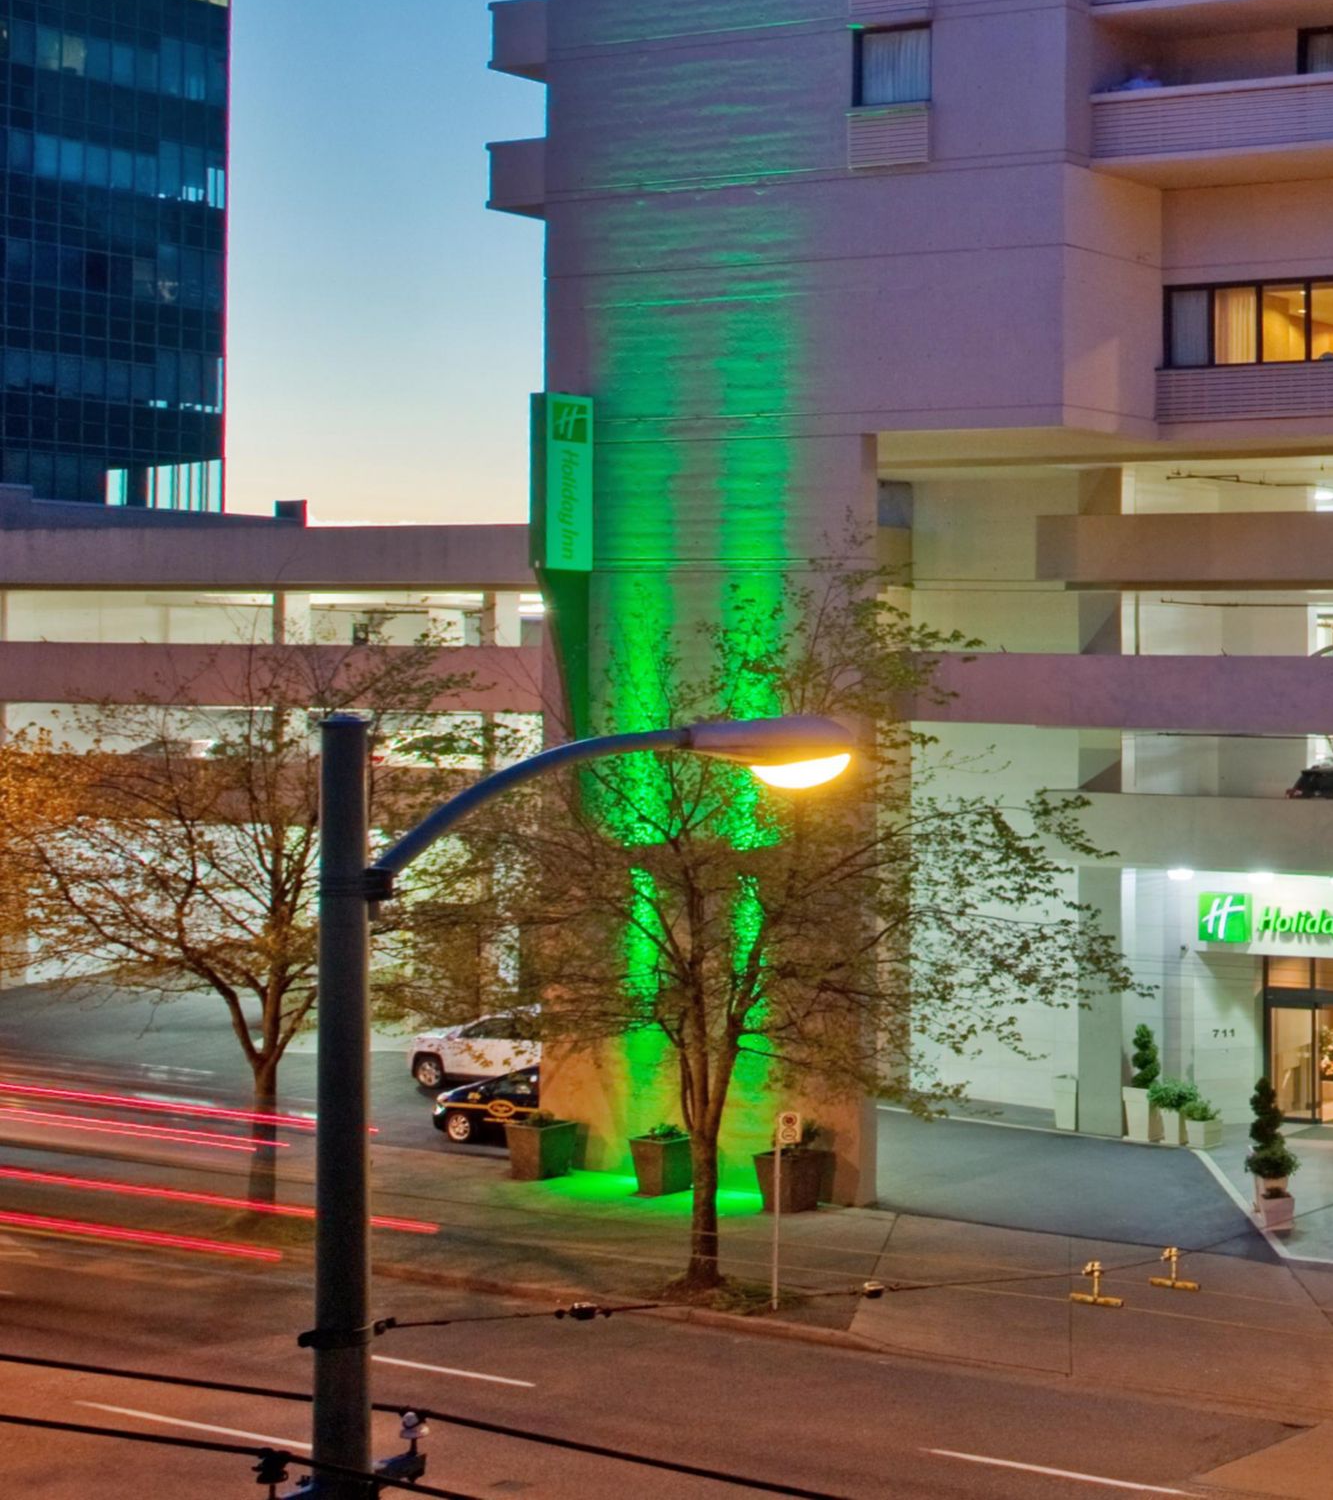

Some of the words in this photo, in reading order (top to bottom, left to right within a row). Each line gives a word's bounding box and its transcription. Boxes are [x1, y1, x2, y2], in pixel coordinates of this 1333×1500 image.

[558, 449, 580, 526] Holiday
[560, 528, 580, 561] Inn
[1212, 1028, 1236, 1039] 711
